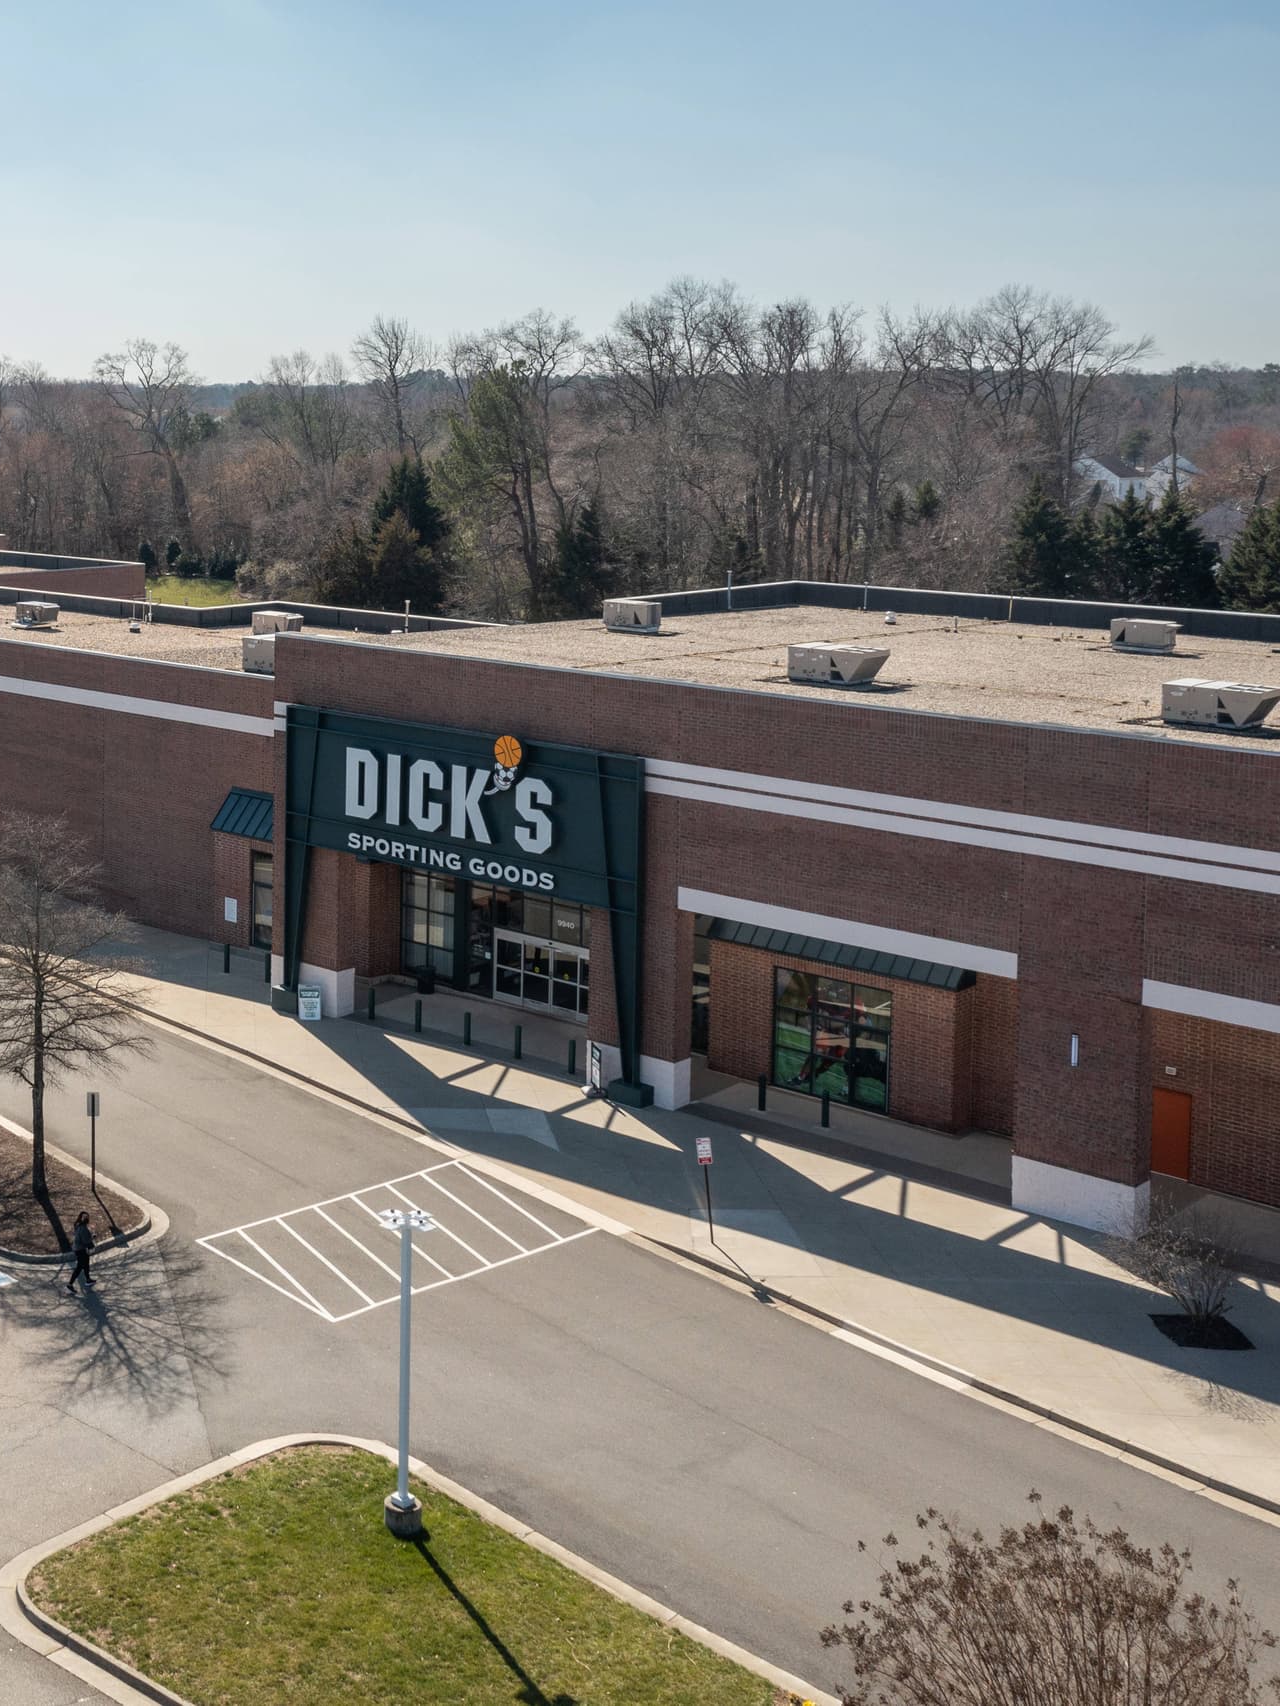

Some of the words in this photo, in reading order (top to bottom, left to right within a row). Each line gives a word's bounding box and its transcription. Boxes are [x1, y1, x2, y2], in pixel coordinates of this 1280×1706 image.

[345, 742, 552, 855] DICK'S
[347, 832, 462, 871] SPORTING
[469, 858, 555, 890] GOODS
